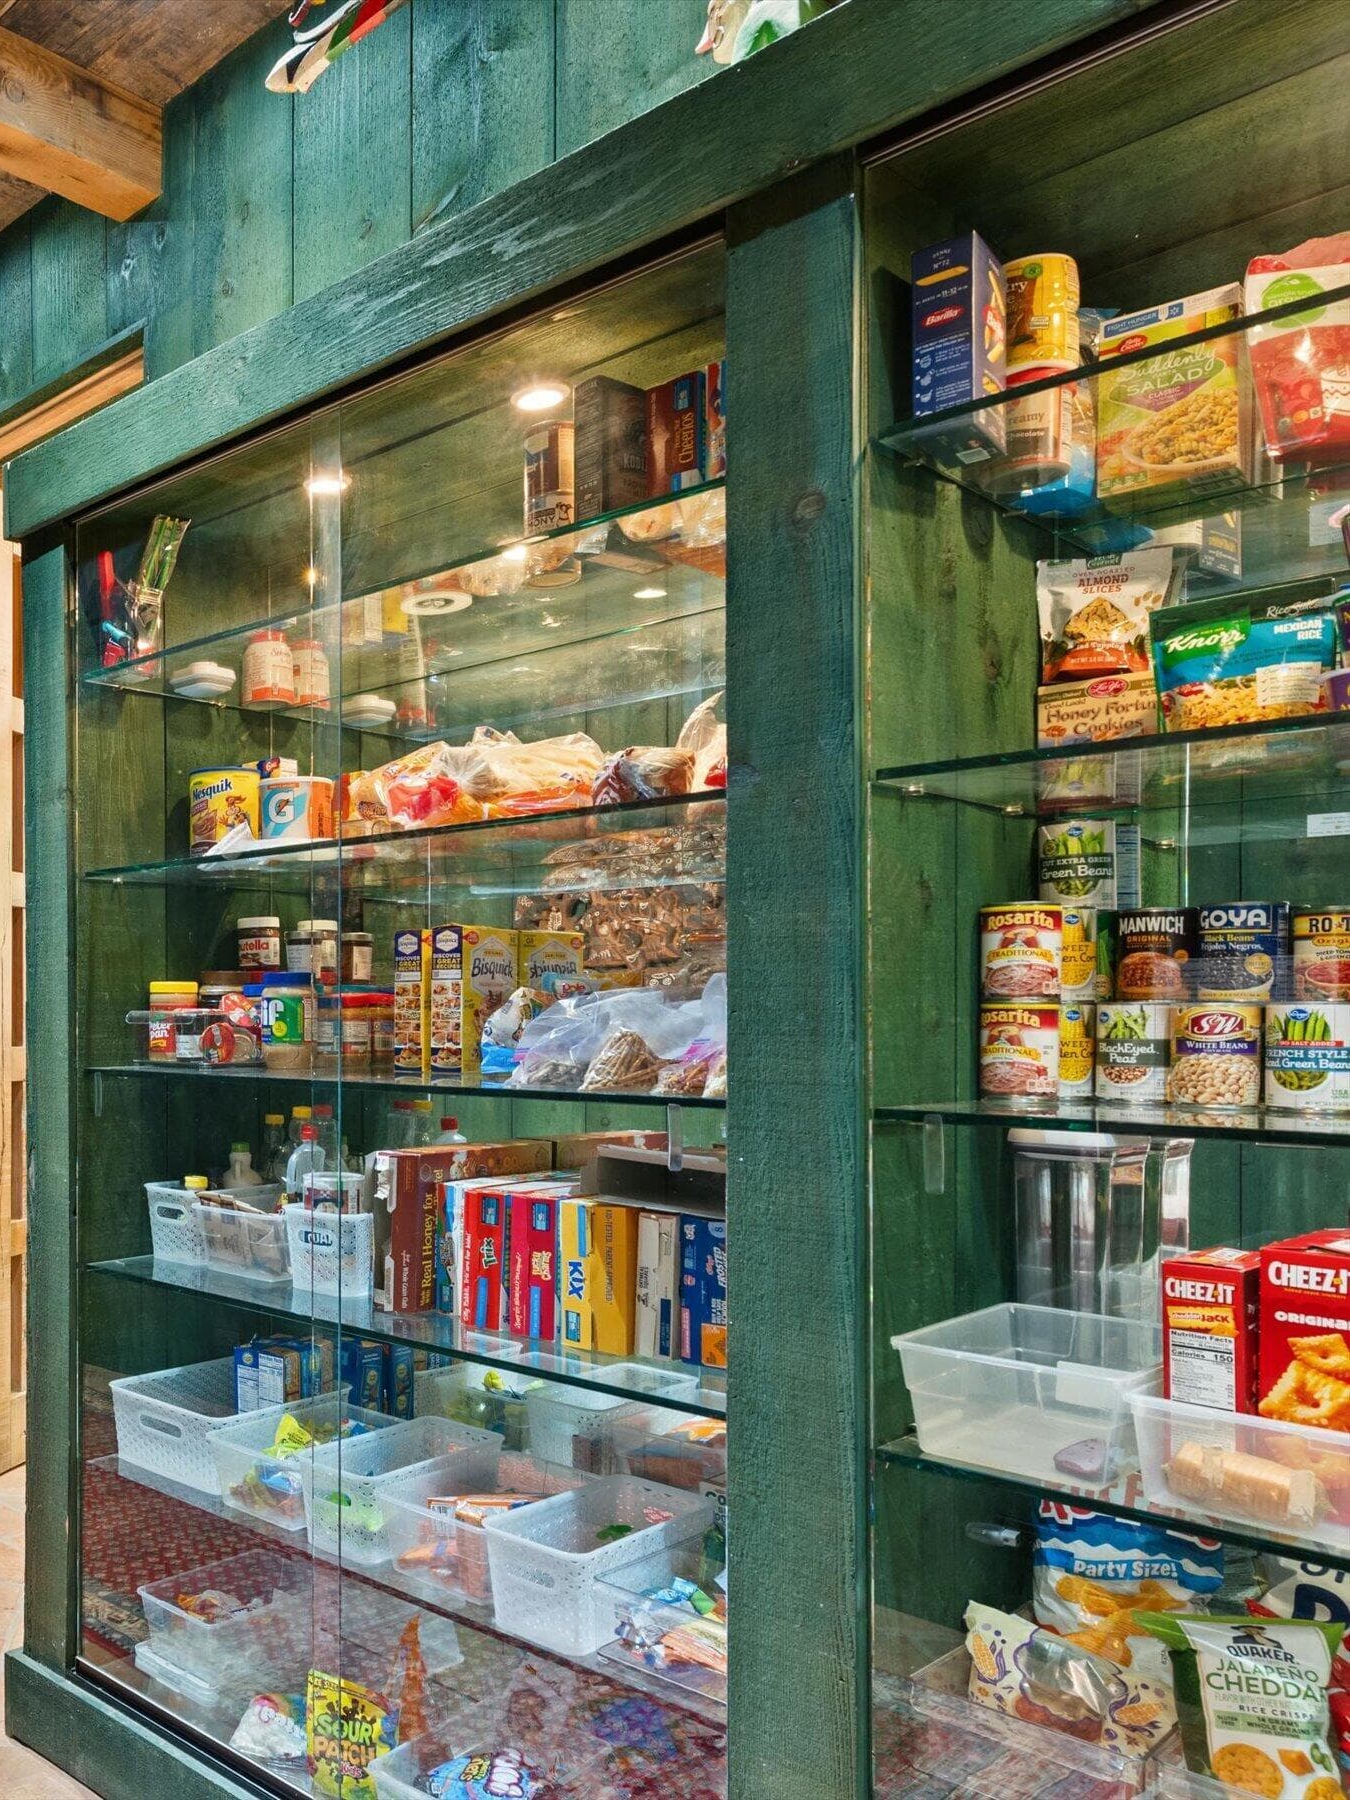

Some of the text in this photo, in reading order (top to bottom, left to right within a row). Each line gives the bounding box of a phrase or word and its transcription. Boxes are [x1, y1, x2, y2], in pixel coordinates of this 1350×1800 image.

[926, 308, 961, 326] Barilla
[1119, 343, 1216, 382] Suddenly
[1127, 368, 1202, 396] SALAD
[1148, 387, 1181, 399] CLASSIC
[678, 412, 694, 464] Cheerios
[1097, 566, 1135, 575] ROASTED
[1078, 573, 1129, 588] ALMOND
[1082, 585, 1122, 595] SLICES
[1266, 605, 1291, 618] Rice
[1273, 619, 1323, 635] MEXICAN
[1297, 630, 1323, 640] RICE
[1166, 628, 1244, 654] Knorr
[1047, 704, 1099, 724] Honey
[1074, 717, 1143, 736] Cookies
[192, 778, 233, 801] Nesquik
[269, 790, 296, 824] G
[1056, 857, 1086, 866] EXTRA
[1042, 864, 1113, 879] Green Beans
[988, 911, 1055, 931] Rosarita
[1119, 916, 1185, 935] MANWICH
[1200, 909, 1267, 929] GOYA
[1205, 934, 1255, 942] Black Beans
[991, 949, 1049, 957] TRADITIONAL
[471, 957, 513, 979] Bisquick
[1186, 1041, 1249, 1049] WHITE BEANS
[1308, 1049, 1348, 1058] STYLE
[1109, 1053, 1137, 1064] Peas
[1282, 1058, 1317, 1069] Green
[422, 1193, 434, 1288] Real Honey for
[479, 1237, 499, 1268] Trix
[713, 1247, 727, 1287] FROSTED
[568, 1261, 586, 1300] KIX
[1171, 1330, 1233, 1344] Nutrition Facts
[1171, 1349, 1234, 1363] Calories 150
[1074, 1559, 1178, 1578] Party Size!
[1227, 1645, 1295, 1665] QUAKER
[1217, 1659, 1319, 1682] JALAPEÑO
[1239, 1705, 1314, 1720] RICE CRISPS
[316, 1713, 374, 1747] SOUR
[1247, 1721, 1276, 1731] WHOLE
[314, 1736, 376, 1767] PATCH
